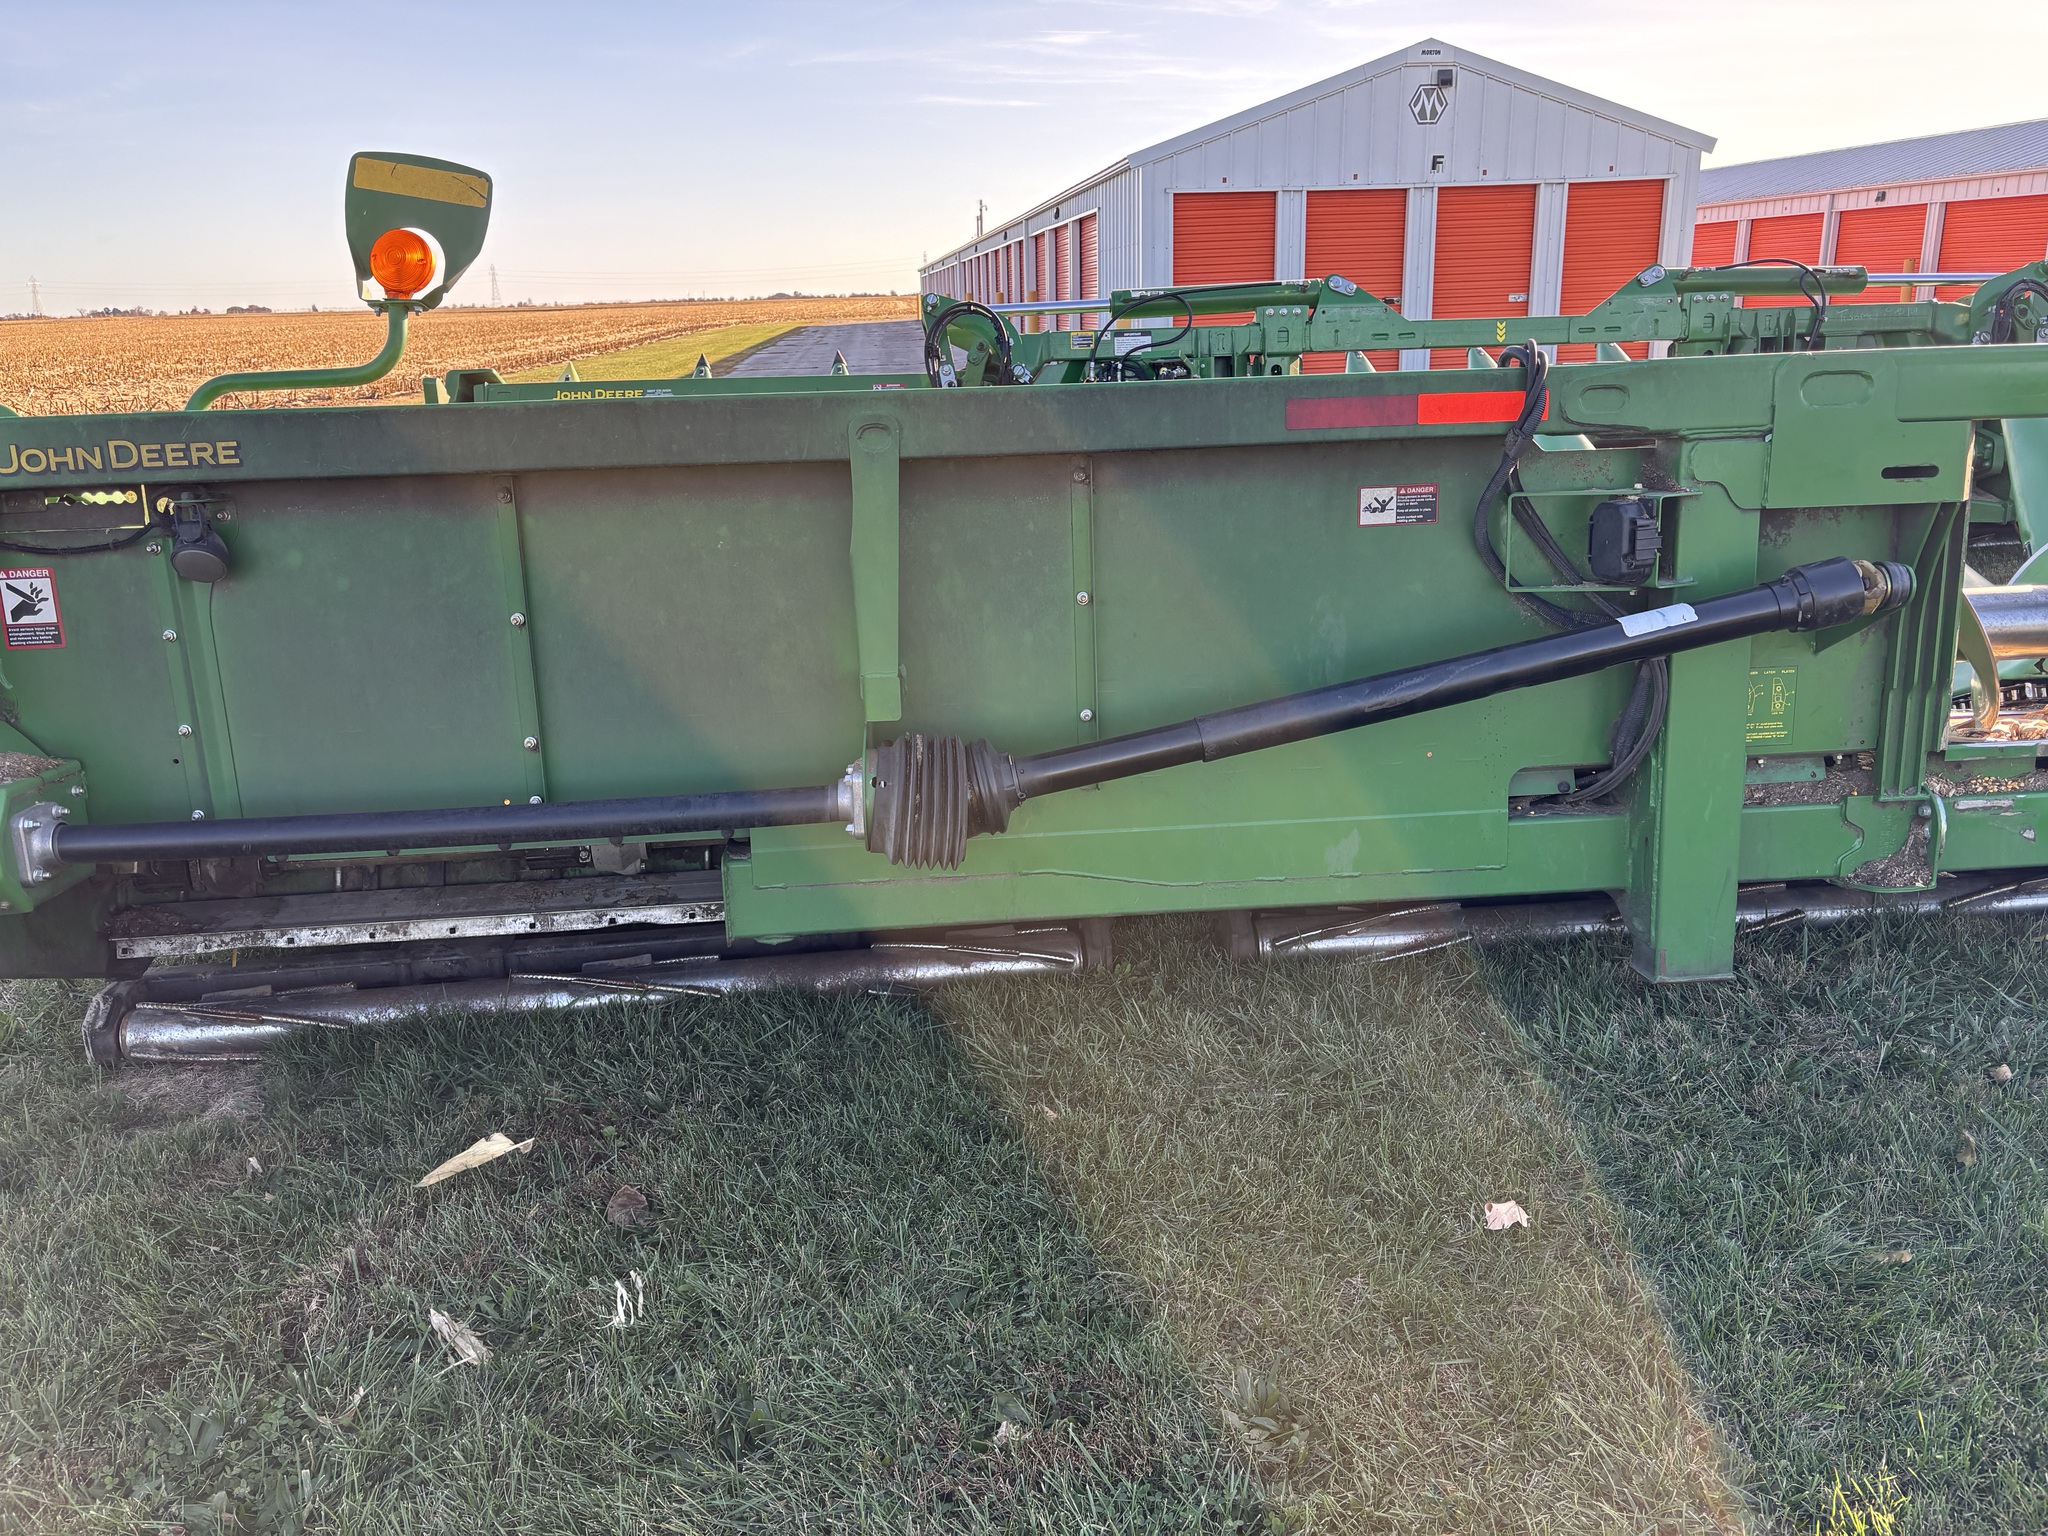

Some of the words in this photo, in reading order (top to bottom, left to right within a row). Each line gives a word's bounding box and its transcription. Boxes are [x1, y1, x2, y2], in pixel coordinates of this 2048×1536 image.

[1431, 155, 1445, 170] F
[552, 390, 592, 400] JOHN
[594, 388, 644, 399] DEERE
[0, 444, 104, 475] JOHN
[107, 439, 243, 469] DEERE
[9, 569, 49, 578] DANGER
